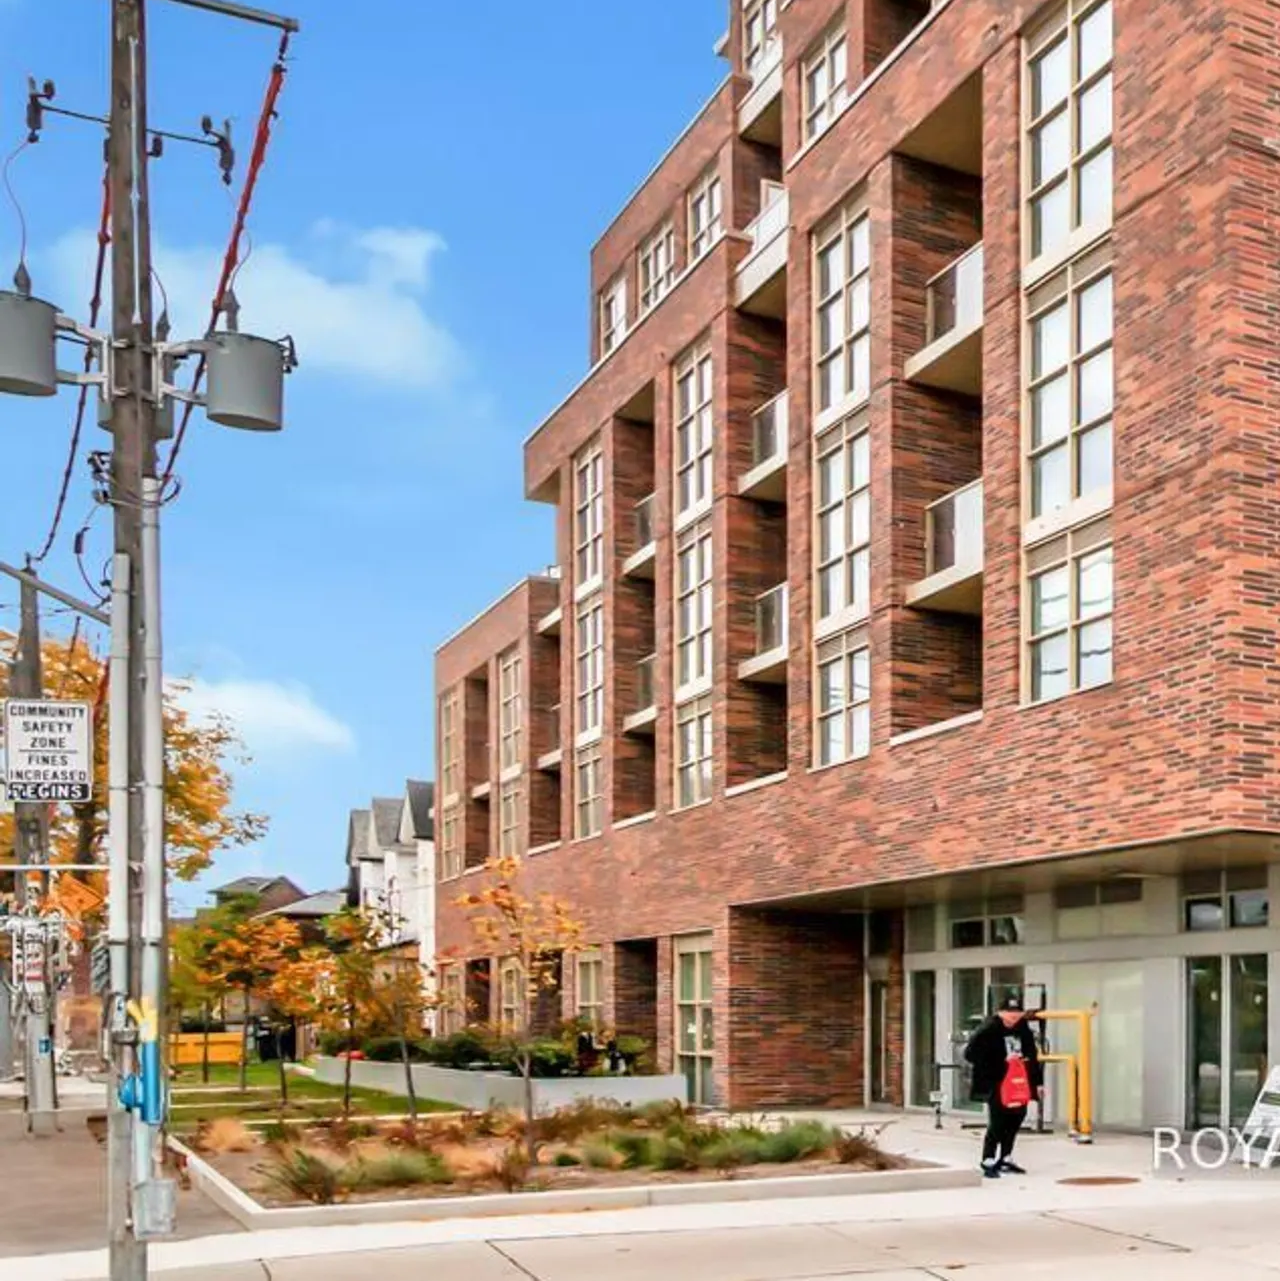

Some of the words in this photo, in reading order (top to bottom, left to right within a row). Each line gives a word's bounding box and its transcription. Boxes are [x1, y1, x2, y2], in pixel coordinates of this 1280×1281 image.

[10, 705, 85, 719] COMMUNITY
[22, 722, 73, 733] SAFETY
[30, 737, 66, 749] ZONE
[28, 755, 68, 767] FINES
[10, 770, 86, 782] INCREASED
